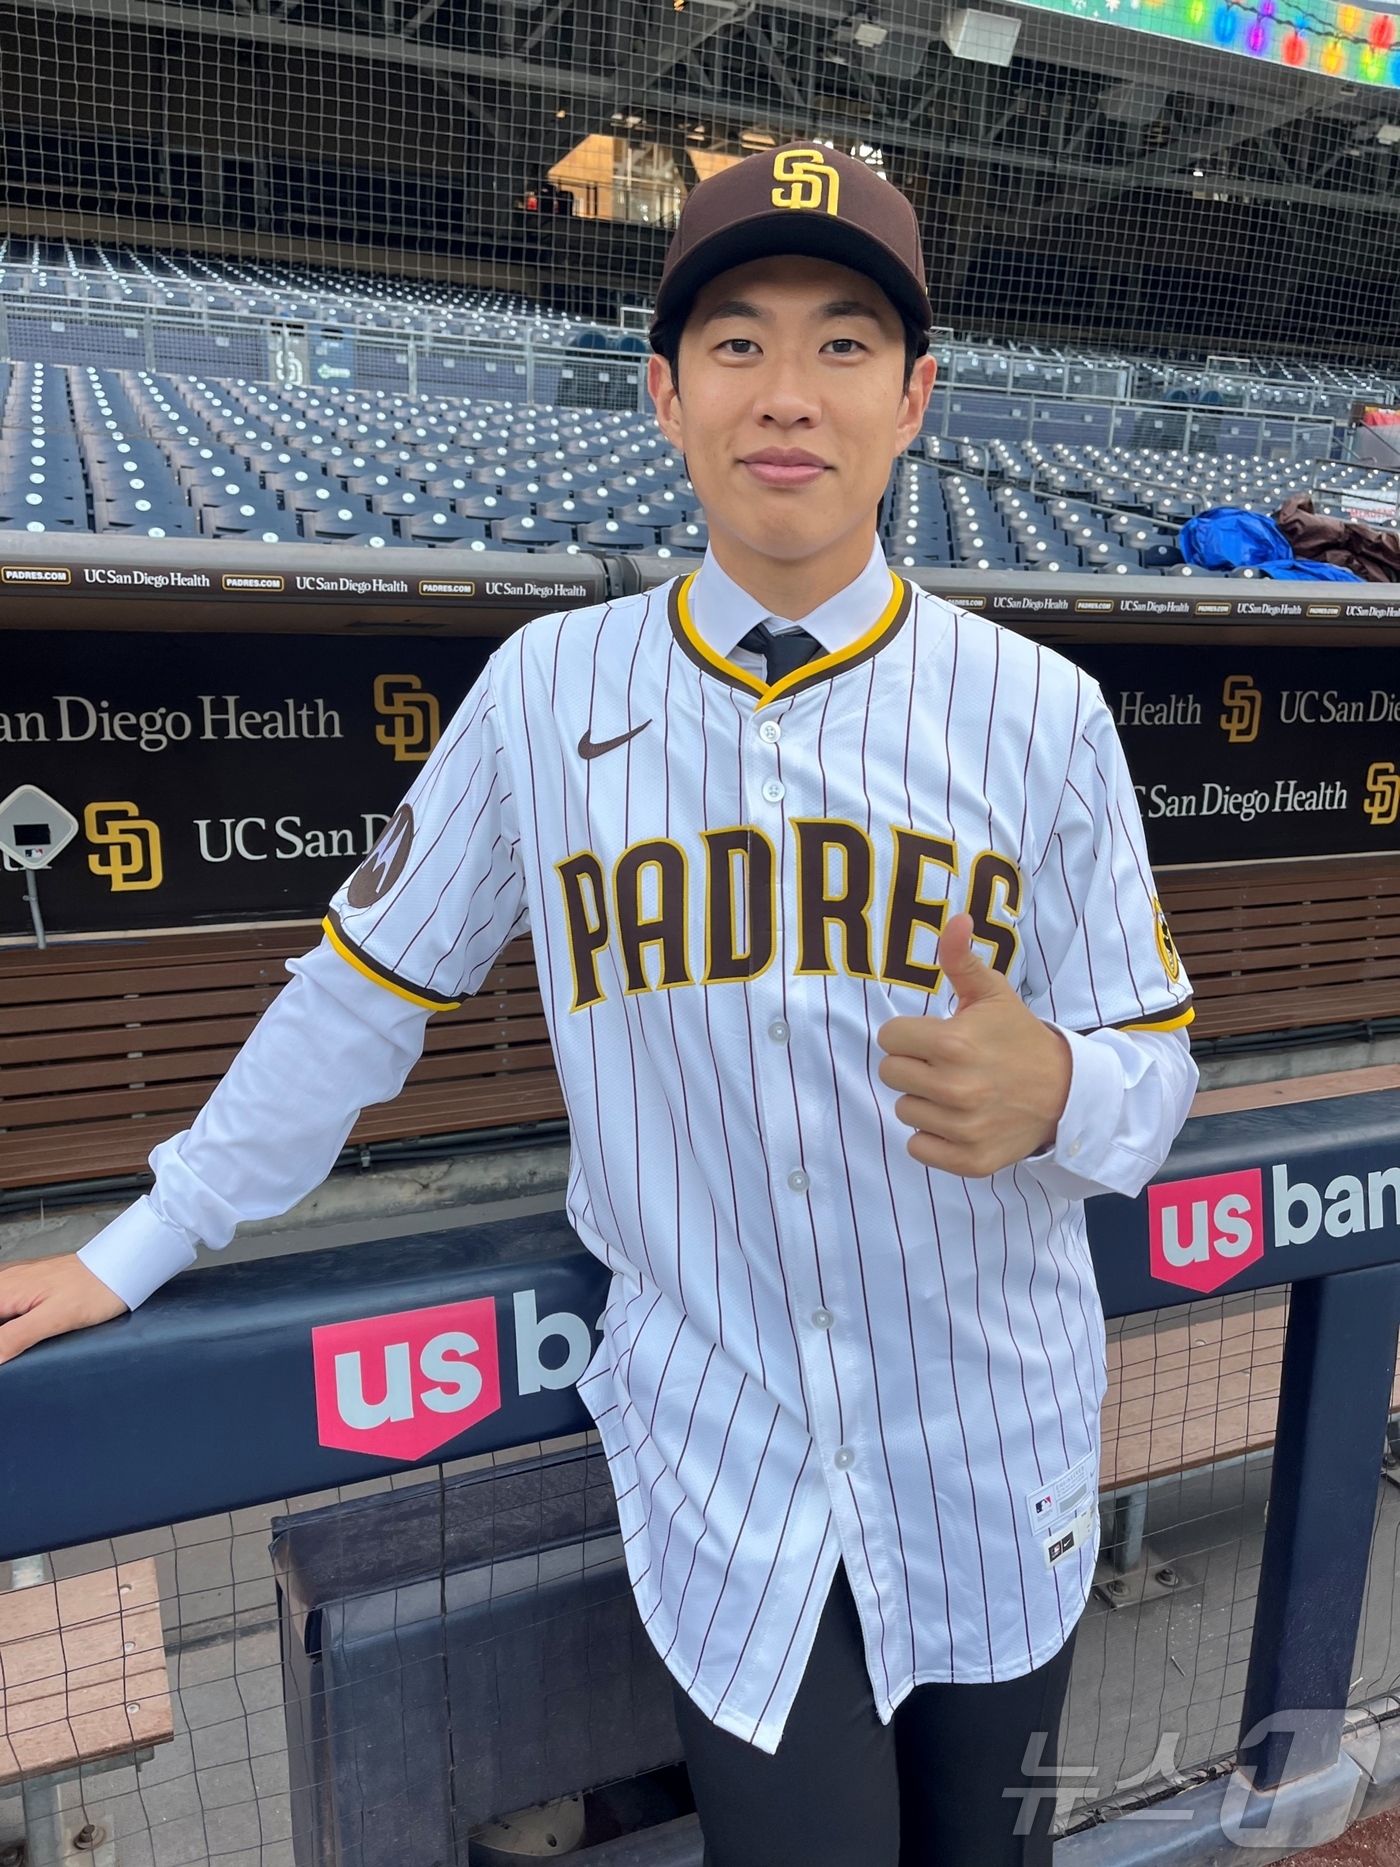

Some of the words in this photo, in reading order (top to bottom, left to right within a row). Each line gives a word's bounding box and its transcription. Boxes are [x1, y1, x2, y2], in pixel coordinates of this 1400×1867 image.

[6, 570, 67, 582] PADRES.COM
[83, 568, 106, 583] UC
[107, 569, 132, 584] San
[132, 570, 169, 588] Diego
[169, 572, 211, 587] Health
[226, 578, 281, 588] PADRES.COM
[295, 576, 315, 590] UC
[316, 577, 338, 591] San
[339, 577, 371, 594] Diego
[371, 578, 408, 593] Health
[422, 584, 472, 593] PADRES.COM
[485, 582, 502, 595] UC
[503, 582, 524, 596] San
[524, 583, 553, 598] Diego
[554, 584, 587, 597] Health
[993, 596, 1006, 608] UC
[1006, 597, 1022, 609] San
[1022, 597, 1044, 611] Diego
[1044, 598, 1069, 610] Health
[1120, 600, 1132, 611] UC
[1132, 600, 1146, 612] San
[1146, 600, 1167, 614] Diego
[1166, 601, 1190, 613] Health
[1117, 691, 1202, 726] Health
[1279, 690, 1319, 724] UC
[1319, 690, 1364, 723] San
[52, 695, 192, 752] Diego
[197, 695, 344, 740] Health
[1148, 784, 1197, 818] San
[1199, 782, 1270, 822] Diego
[1271, 780, 1348, 813] Health
[193, 817, 268, 863] UC
[274, 816, 357, 860] San
[554, 817, 1024, 1014] PADRES
[1161, 1193, 1253, 1267] us
[334, 1331, 483, 1430] us
